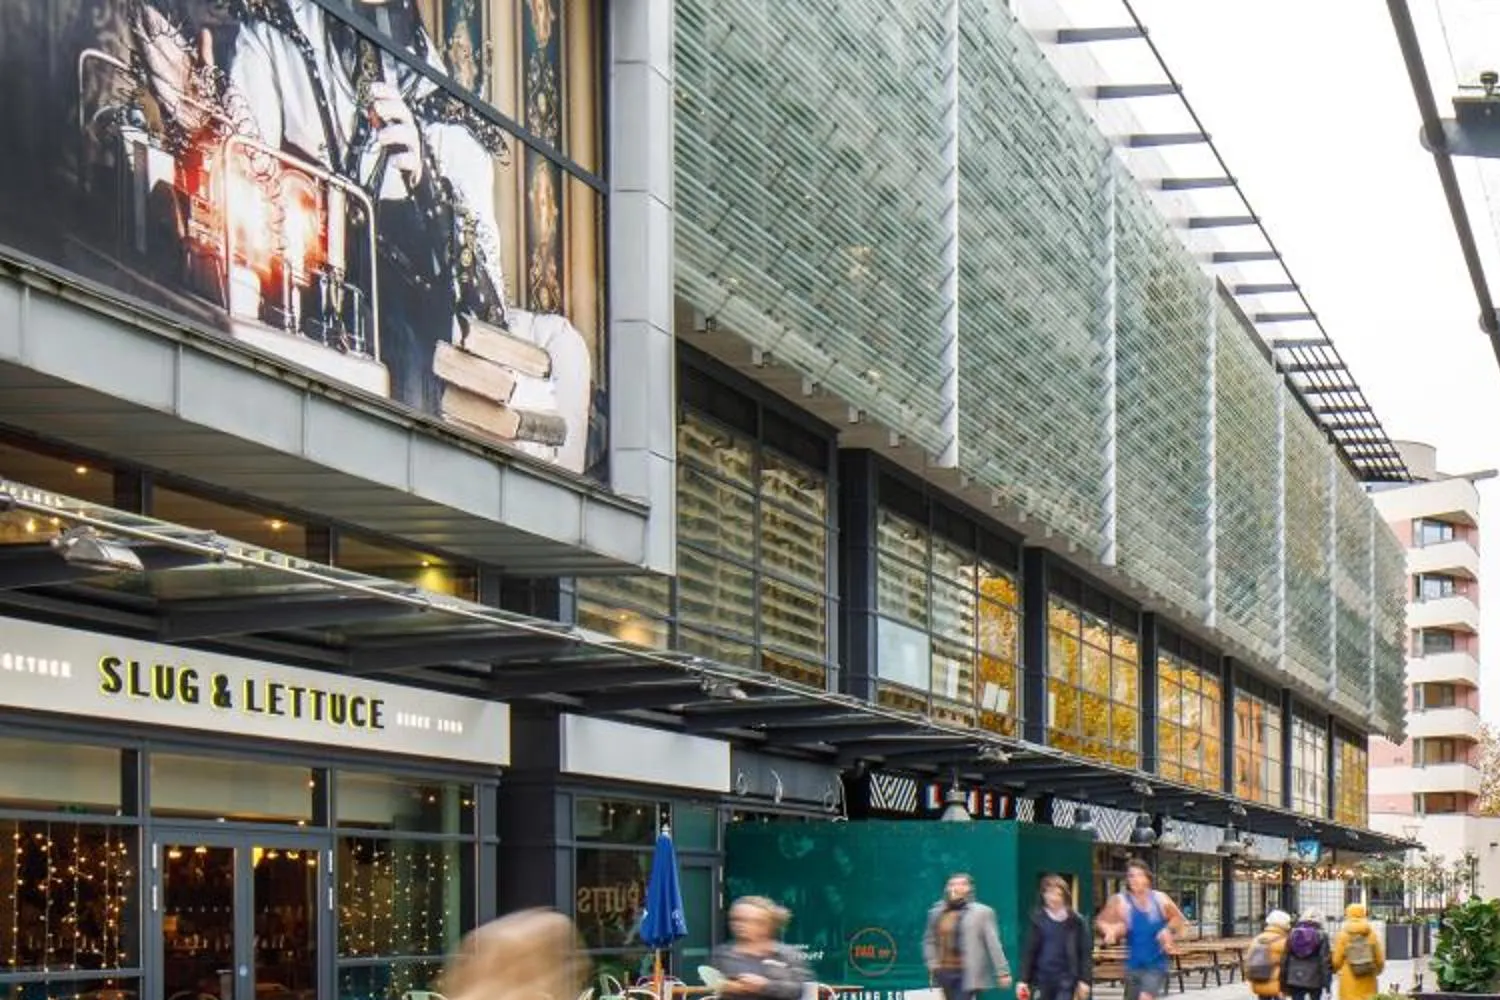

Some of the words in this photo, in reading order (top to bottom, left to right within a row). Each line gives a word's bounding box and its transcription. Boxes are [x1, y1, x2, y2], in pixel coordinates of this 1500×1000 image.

[98, 655, 200, 705] SLUG
[209, 671, 233, 708] &
[243, 677, 385, 730] LETTUCE
